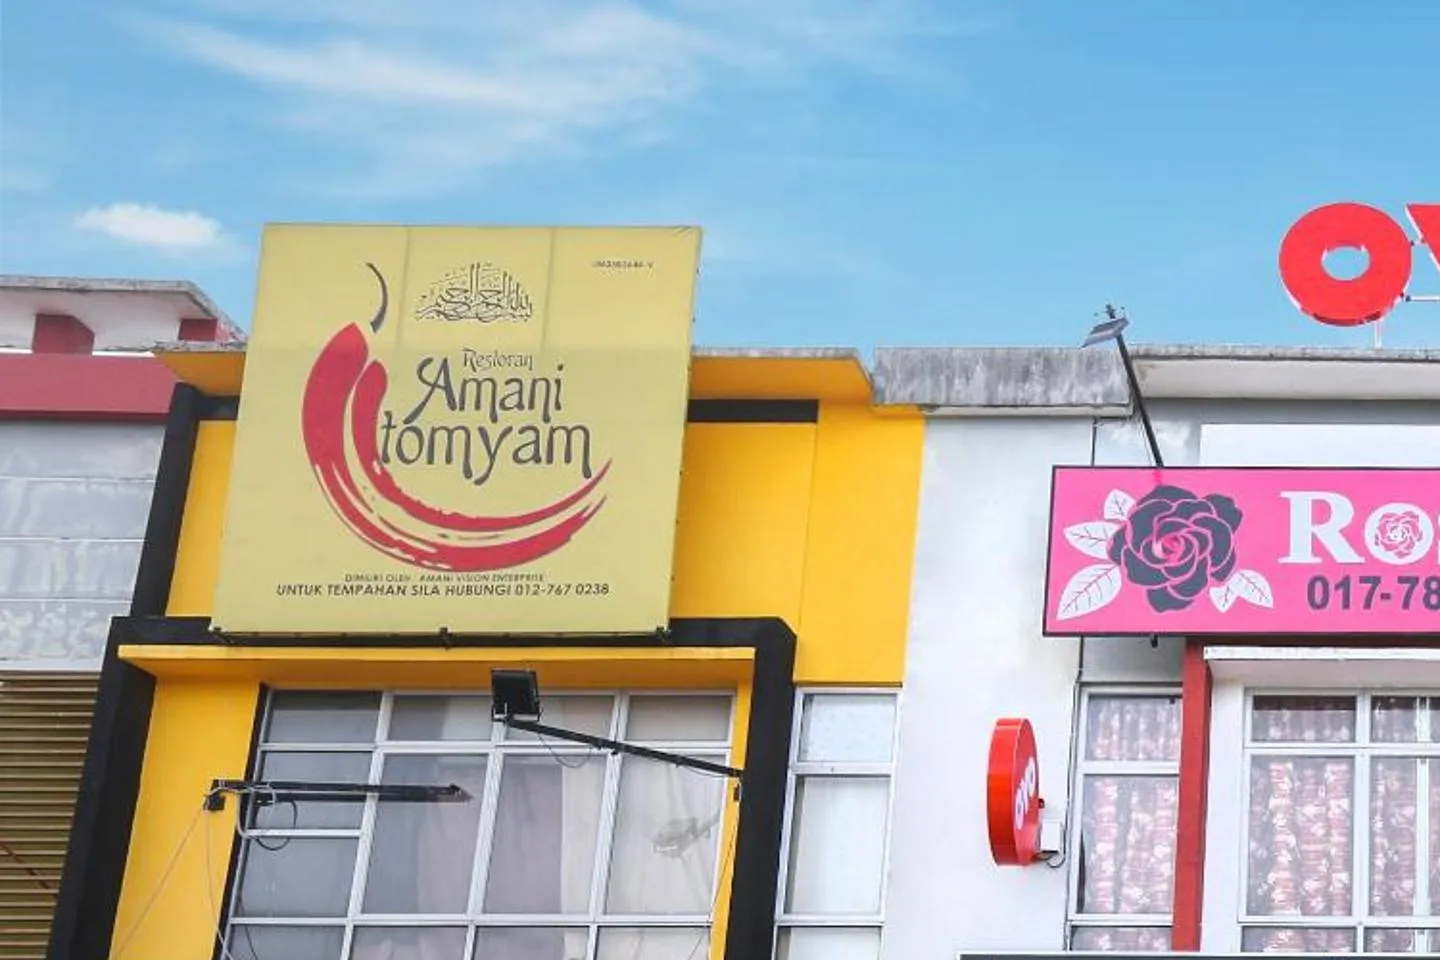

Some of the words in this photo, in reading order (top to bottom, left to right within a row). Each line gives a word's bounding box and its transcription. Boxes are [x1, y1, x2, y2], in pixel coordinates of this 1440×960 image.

[463, 348, 533, 371] Restoran
[403, 357, 565, 424] Amani
[380, 411, 593, 484] tomyam
[276, 585, 322, 596] UNTUK
[327, 584, 408, 596] TEMPAHAN
[411, 584, 440, 596] SILA
[446, 584, 512, 596] HUBUNGI
[514, 584, 572, 596] 012-767
[576, 584, 610, 595] 0238
